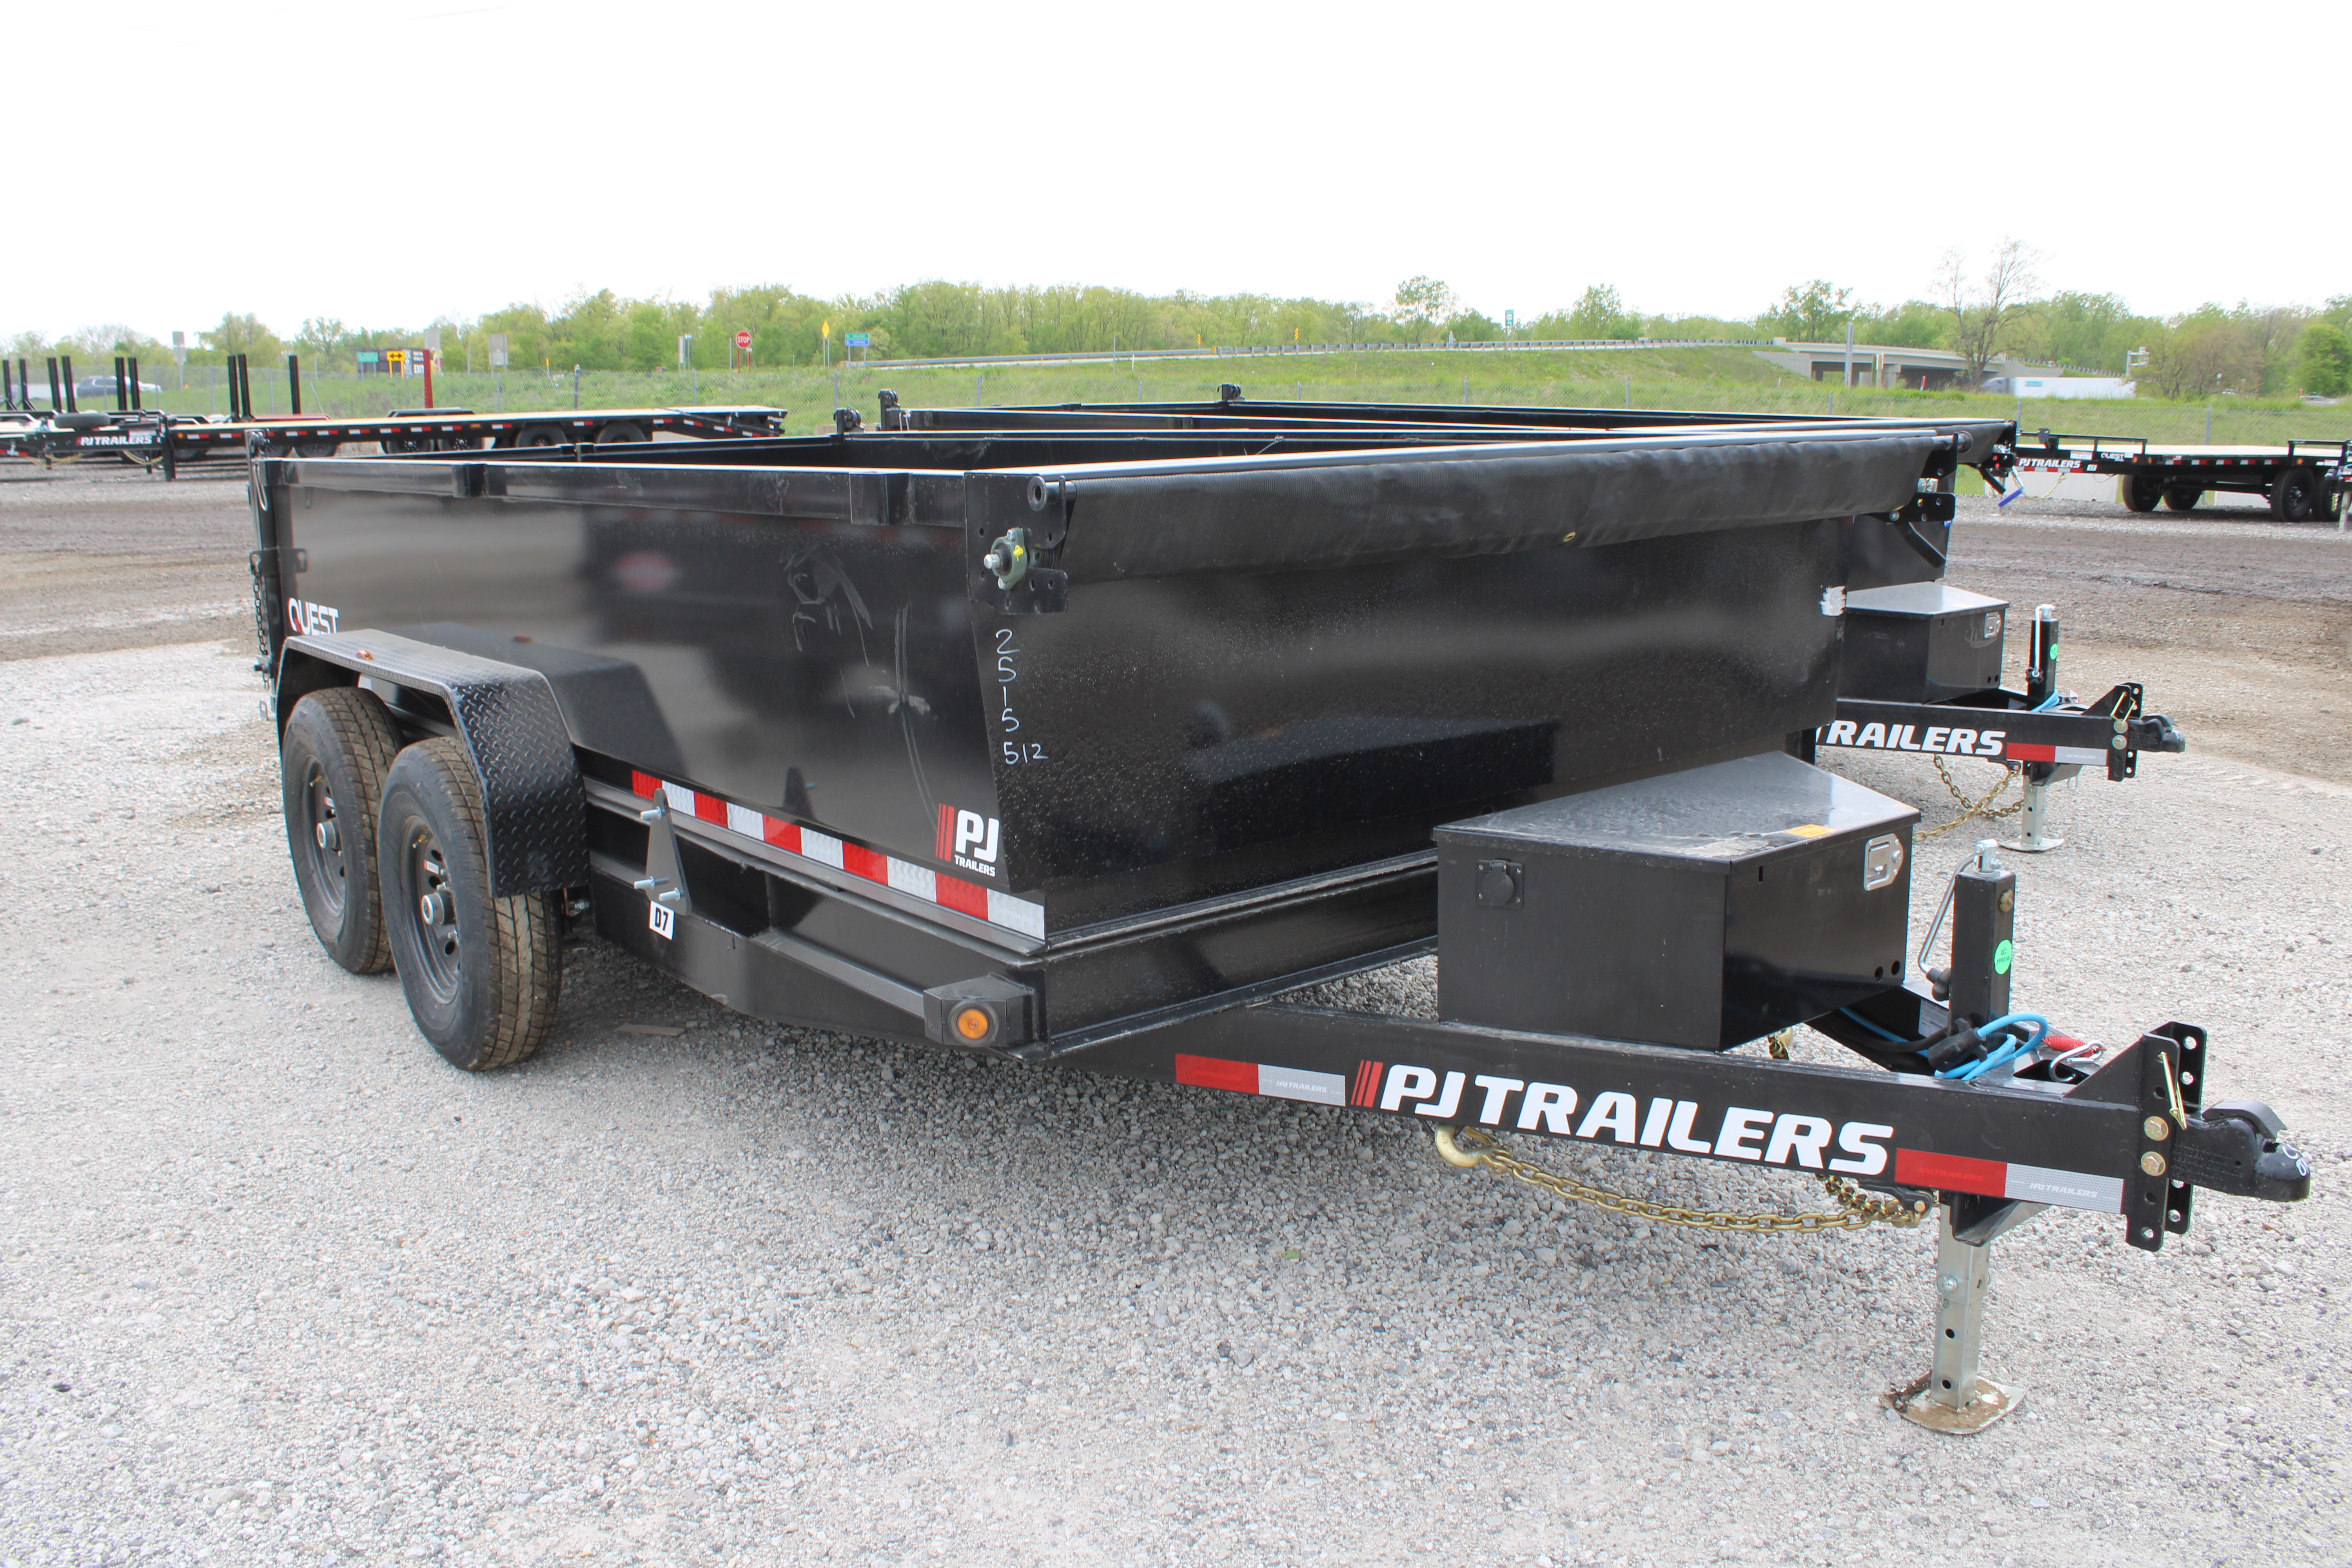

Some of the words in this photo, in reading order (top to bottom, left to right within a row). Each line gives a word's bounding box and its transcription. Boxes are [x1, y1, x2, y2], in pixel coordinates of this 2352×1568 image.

[289, 597, 339, 635] QUEST
[1816, 720, 2006, 756] RAILERS
[955, 809, 1000, 863] PJ
[955, 854, 996, 877] TRAILERS
